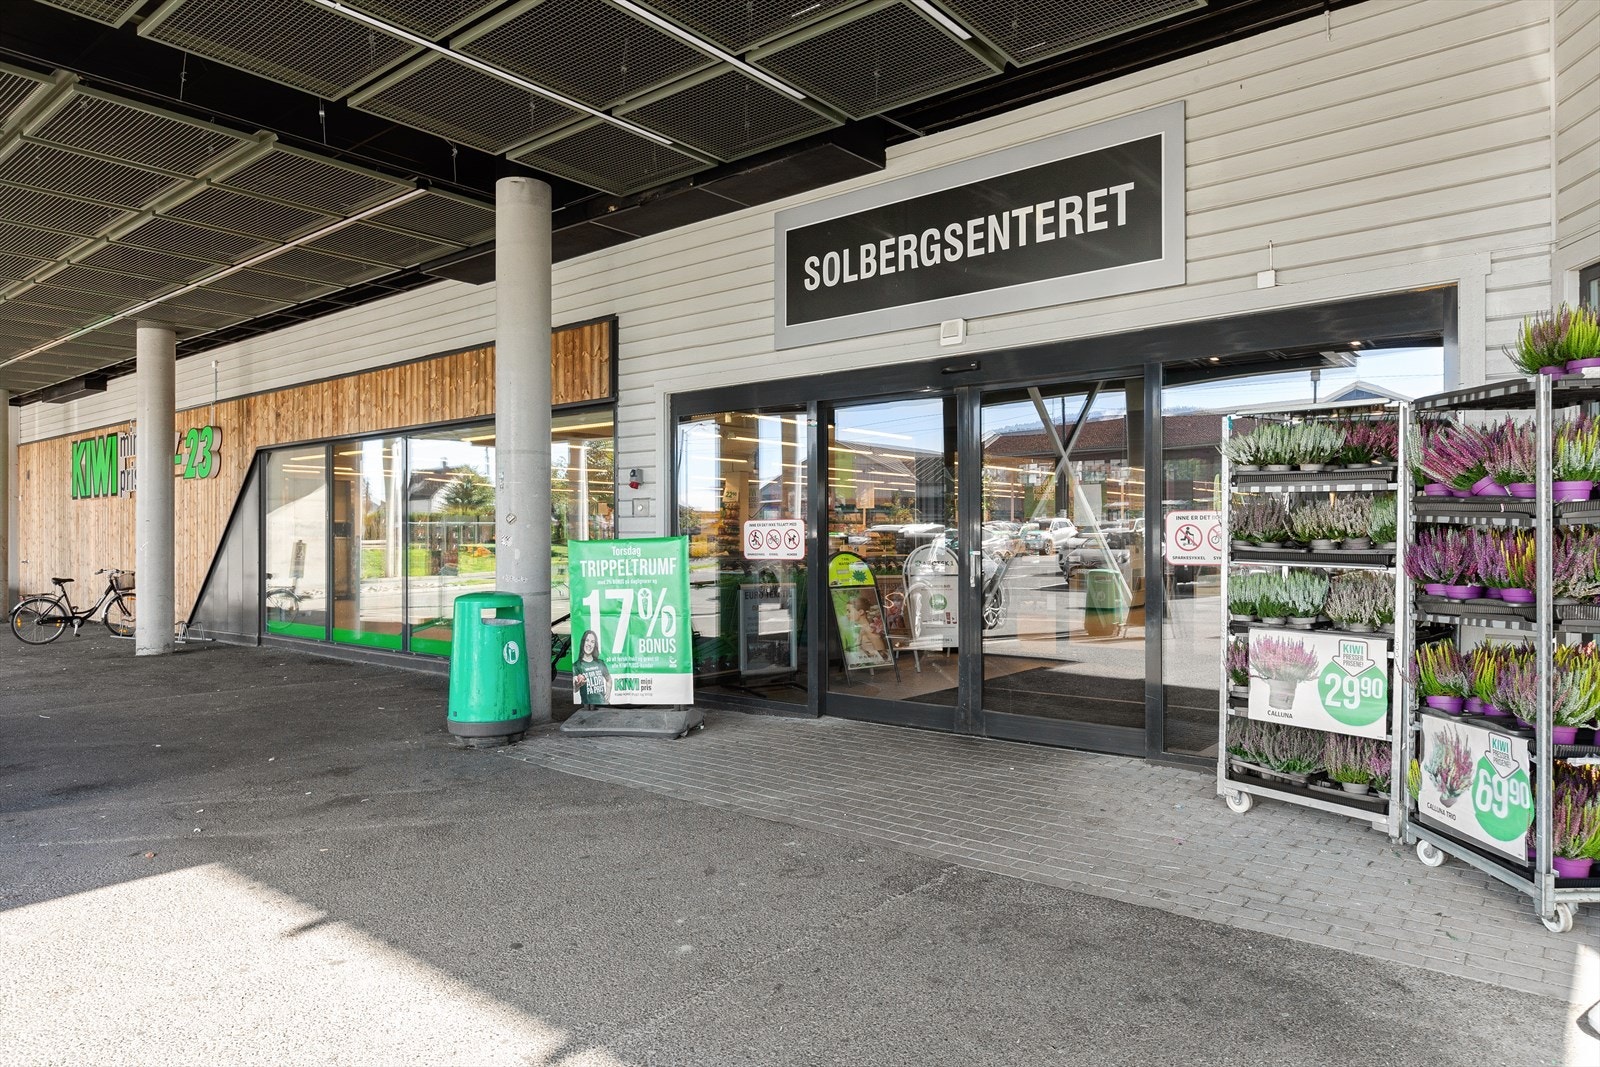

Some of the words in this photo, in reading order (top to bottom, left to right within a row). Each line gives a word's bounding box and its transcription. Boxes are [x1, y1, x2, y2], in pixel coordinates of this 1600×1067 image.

[804, 181, 1135, 291] SOLBERGSENTERET
[119, 427, 137, 458] mi
[174, 425, 214, 480] -23
[71, 434, 118, 499] KIWI
[611, 545, 642, 556] Torsdag
[580, 557, 677, 578] TRIPPELTRUMF
[582, 587, 677, 654] 17%
[639, 637, 677, 654] BONUS
[1343, 643, 1364, 654] KIWI
[1343, 653, 1364, 661] PRESSER
[614, 677, 640, 691] KIWI
[641, 684, 652, 692] pris
[1267, 709, 1293, 719] CALLUNA
[1492, 737, 1509, 753] KIWI
[1426, 801, 1447, 816] CALLUNA
[1446, 810, 1457, 821] TRIO
